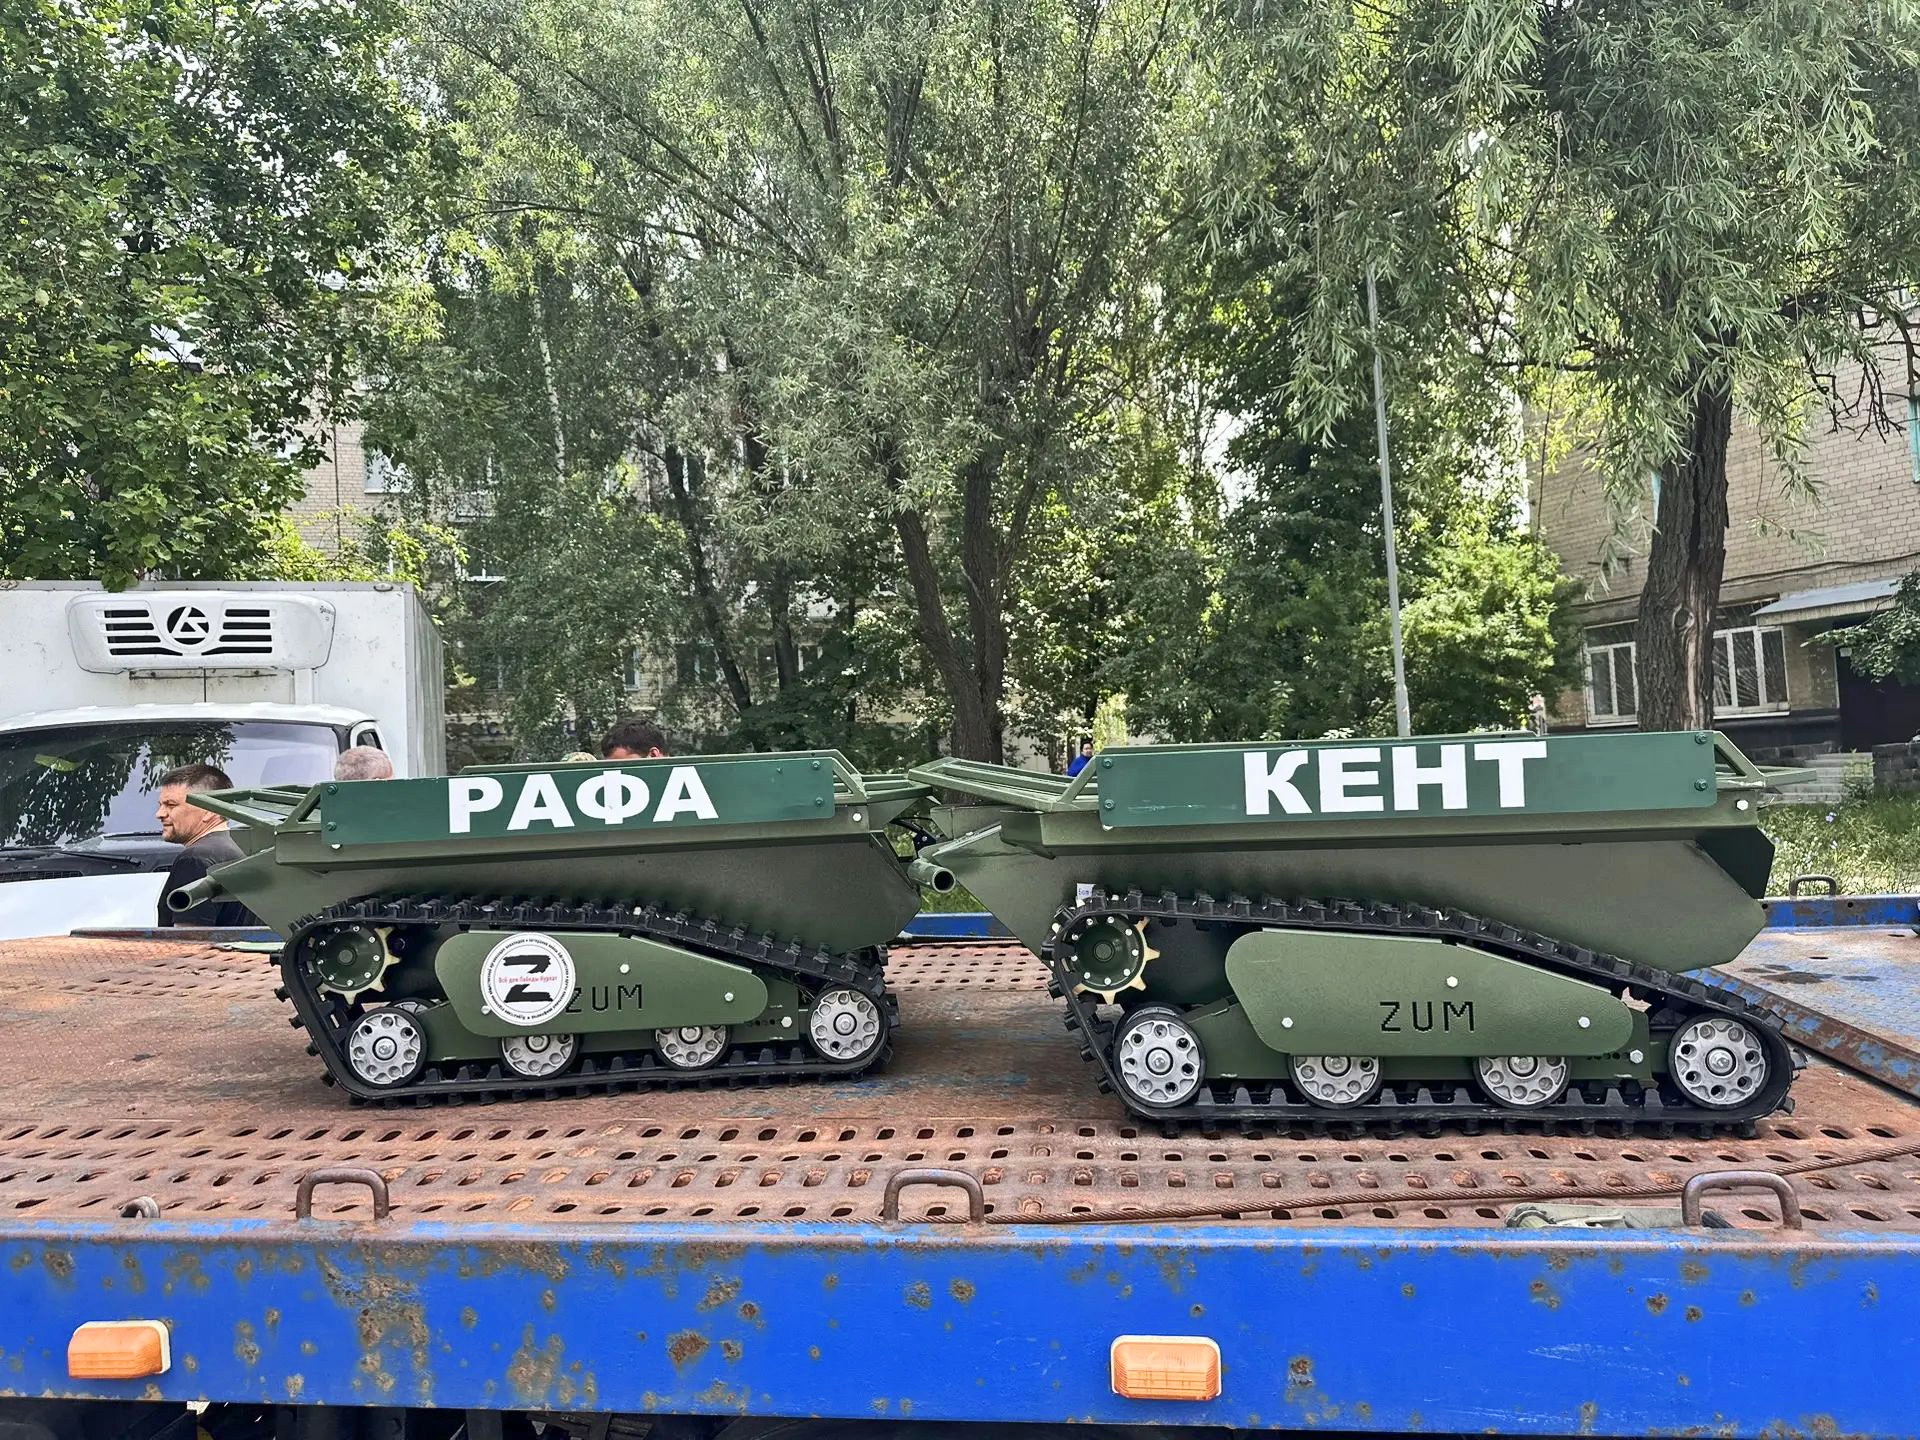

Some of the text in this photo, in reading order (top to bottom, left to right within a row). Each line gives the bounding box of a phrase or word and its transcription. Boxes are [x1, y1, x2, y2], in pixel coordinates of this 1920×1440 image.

[448, 766, 719, 834] РАФА
[1244, 741, 1547, 815] КЕНТ
[565, 984, 643, 1013] ZUM
[1379, 1001, 1475, 1033] ZUM
